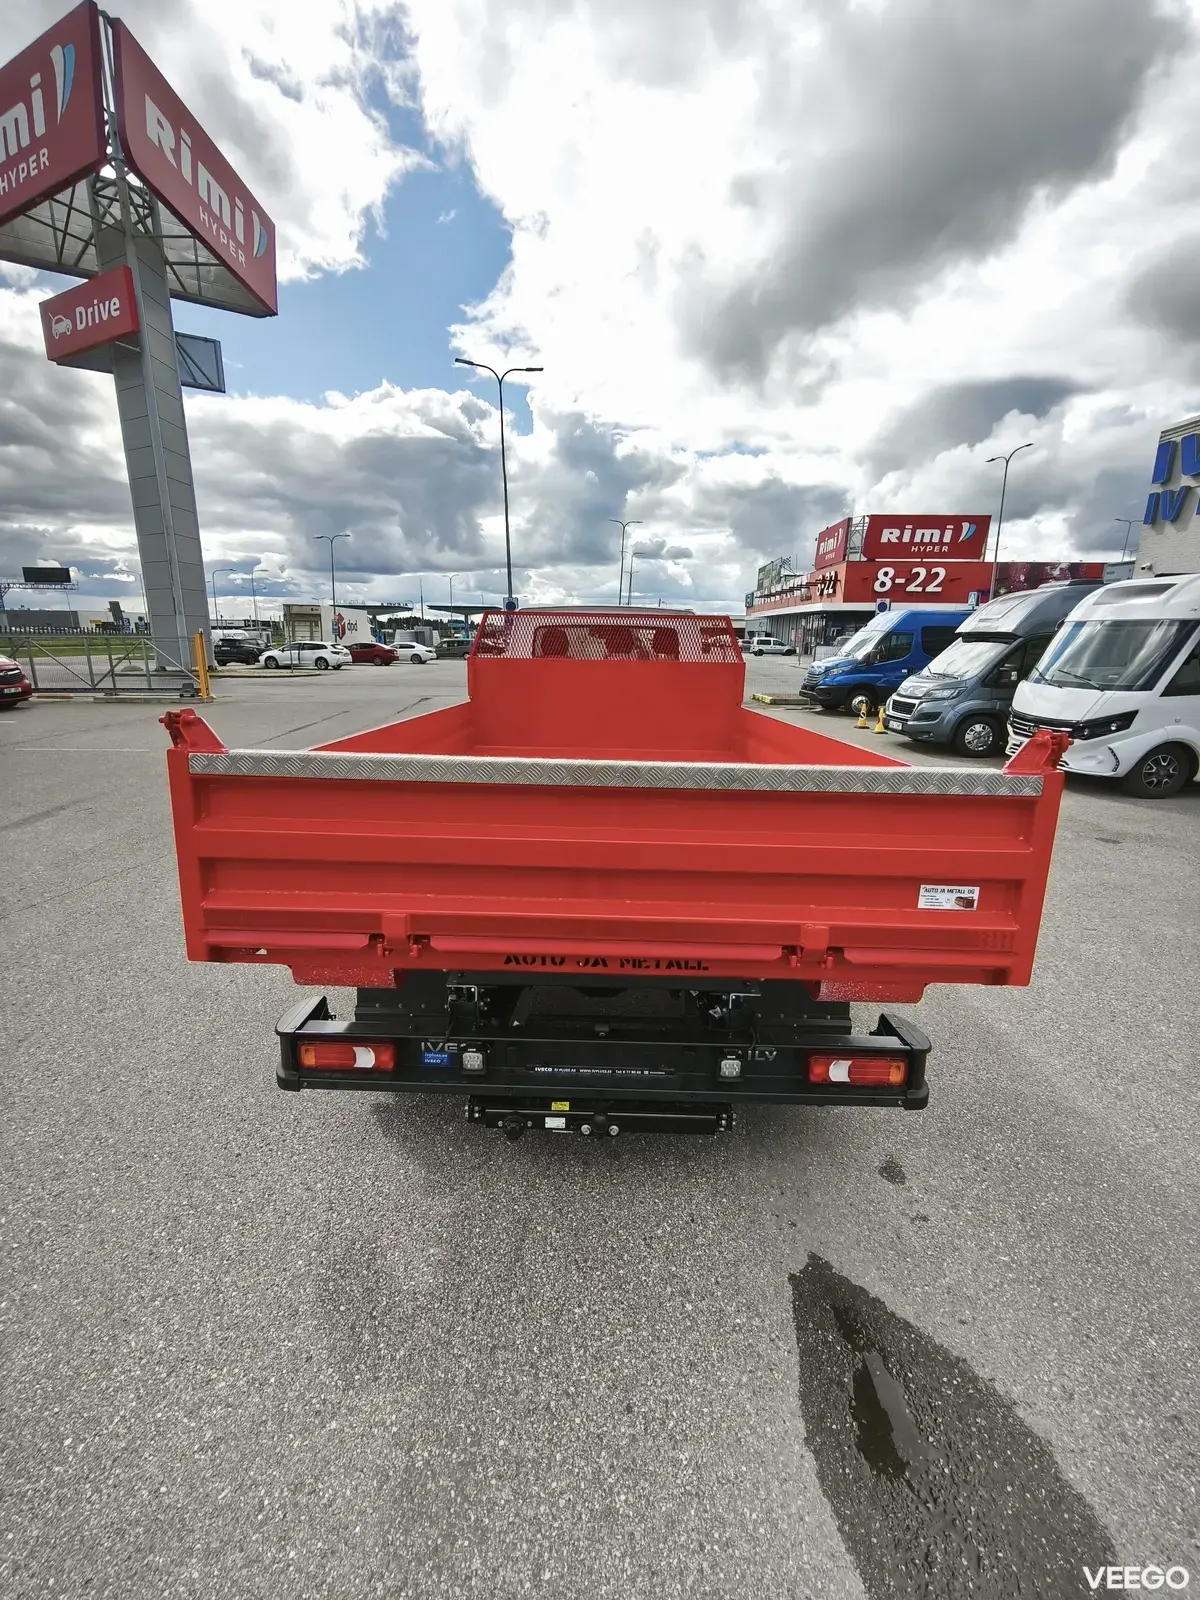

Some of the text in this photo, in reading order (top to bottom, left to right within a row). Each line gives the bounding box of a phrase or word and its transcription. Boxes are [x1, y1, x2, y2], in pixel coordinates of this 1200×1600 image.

[0, 147, 49, 196] HYPER
[145, 93, 244, 245] Rimi
[199, 205, 247, 269] HYPER
[75, 296, 120, 331] Drive
[880, 525, 954, 543] Rimi
[873, 566, 946, 592] 8-22
[347, 619, 358, 634] dpd
[504, 955, 566, 966] AUTO
